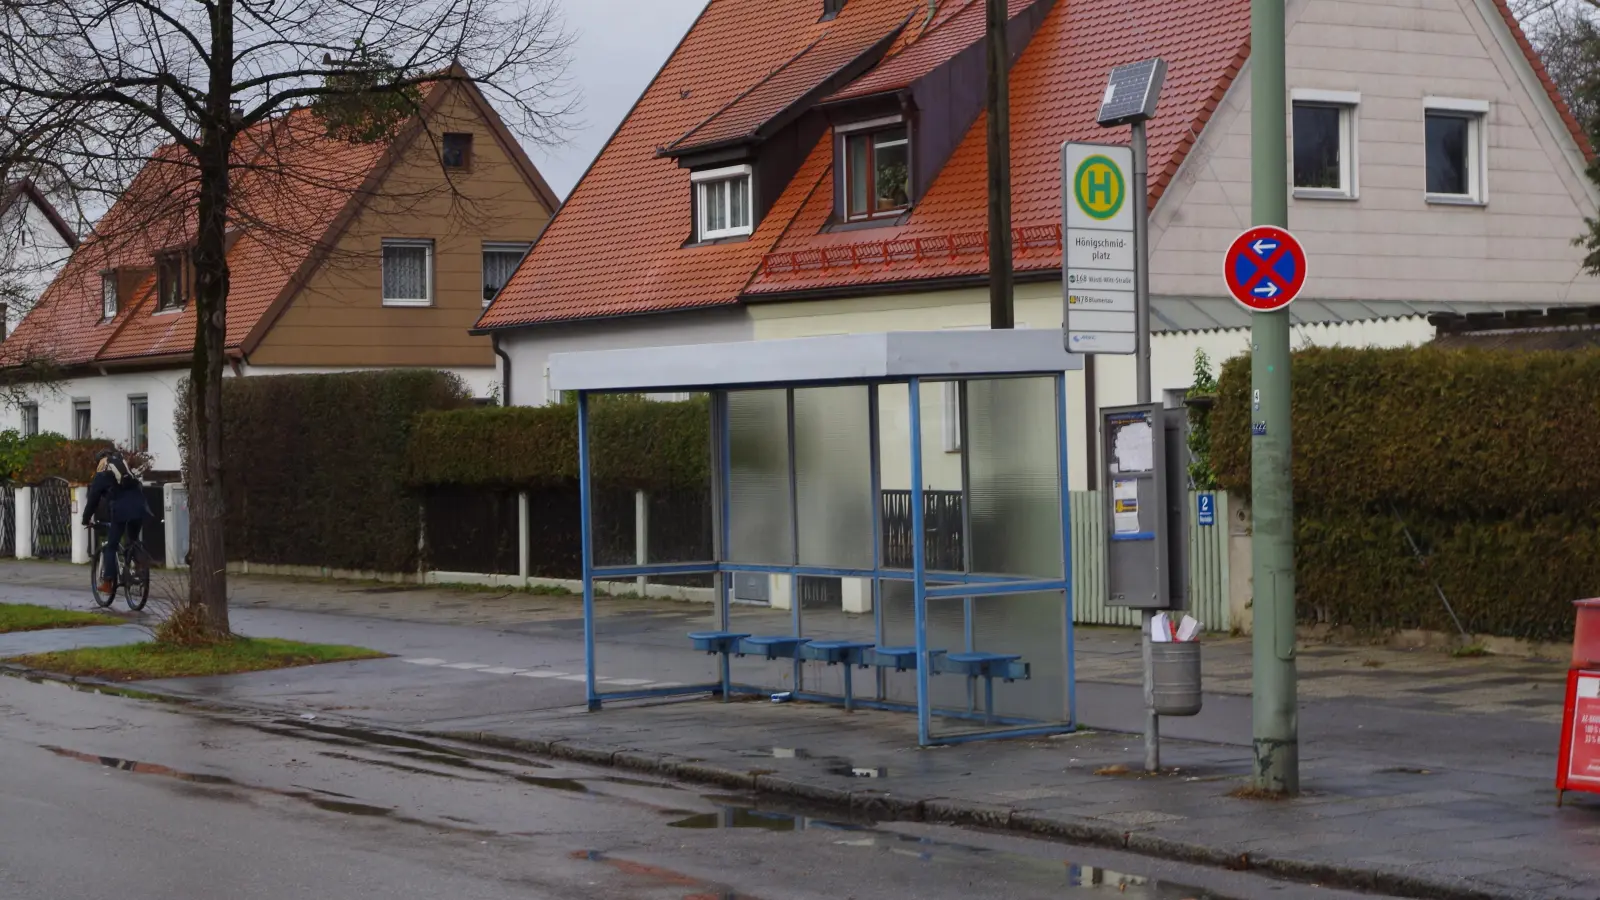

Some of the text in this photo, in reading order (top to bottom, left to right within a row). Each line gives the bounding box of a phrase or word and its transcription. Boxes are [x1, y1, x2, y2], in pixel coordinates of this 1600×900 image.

[1088, 170, 1111, 204] H
[1075, 236, 1127, 249] Hönigschmid-
[1092, 250, 1111, 261] platz
[1201, 496, 1209, 511] 2
